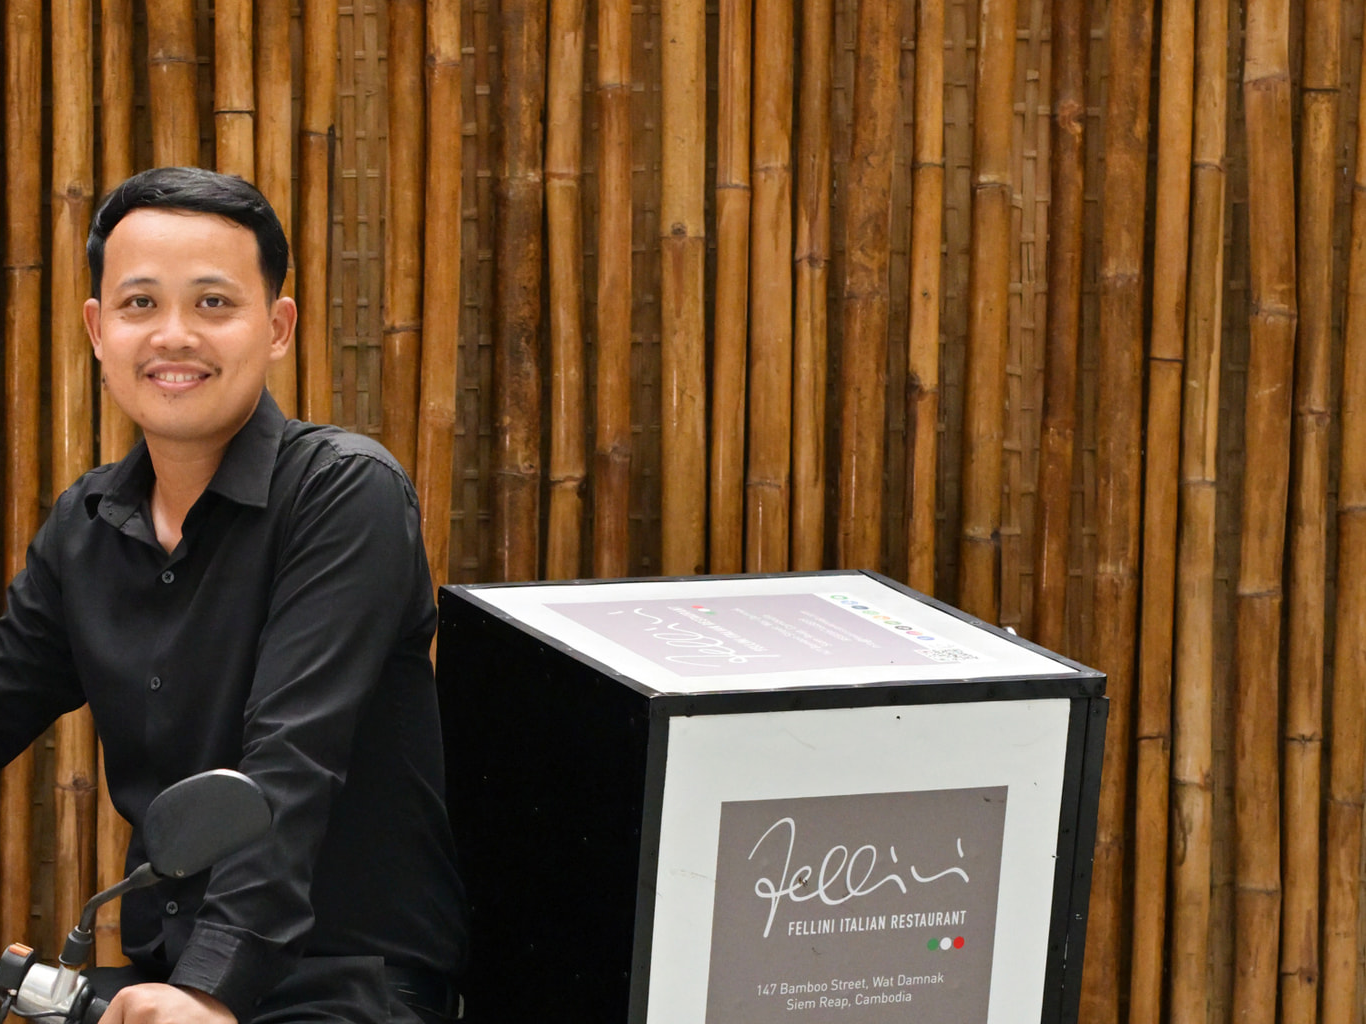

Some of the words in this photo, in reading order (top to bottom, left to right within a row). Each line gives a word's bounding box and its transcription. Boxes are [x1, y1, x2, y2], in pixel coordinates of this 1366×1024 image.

[748, 817, 970, 938] Fellini
[788, 919, 835, 936] FELLINI
[840, 915, 886, 932] ITALIAN
[890, 910, 967, 929] RESTAURANT
[756, 983, 777, 996] 147
[779, 981, 828, 995] Bamboo
[830, 978, 869, 991] Street,
[872, 976, 894, 988] Wat
[897, 972, 944, 986] Damnak
[786, 998, 816, 1011] Siem
[819, 996, 851, 1010] Reap,
[855, 991, 912, 1006] Cambodia
